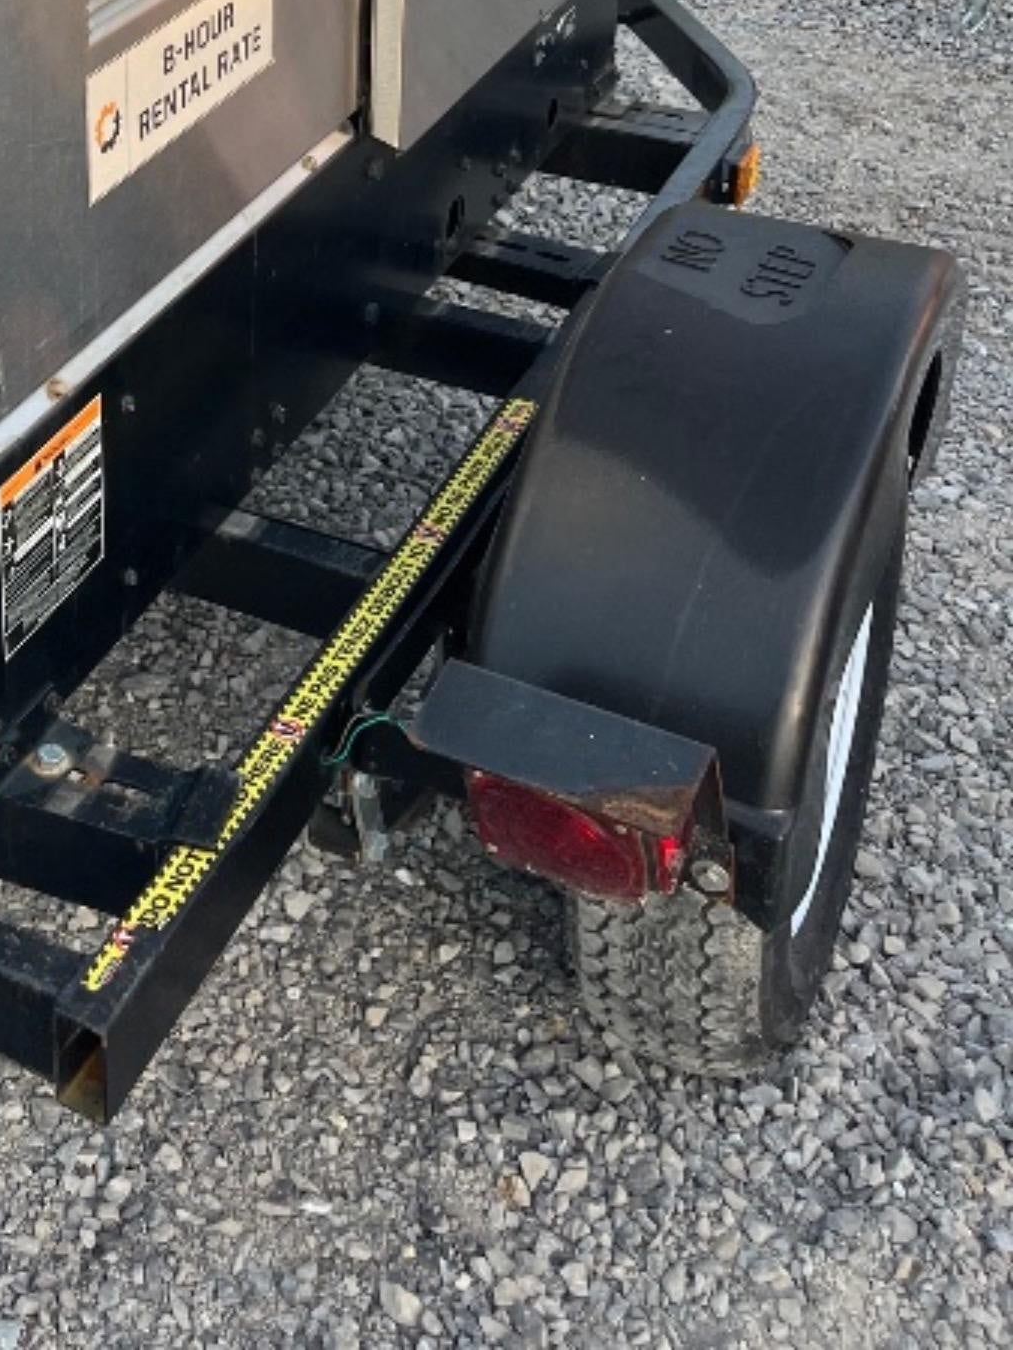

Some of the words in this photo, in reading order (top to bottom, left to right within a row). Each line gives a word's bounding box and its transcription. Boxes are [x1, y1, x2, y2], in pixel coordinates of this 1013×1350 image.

[139, 65, 212, 141] RENTAL
[217, 23, 262, 80] RATE
[660, 229, 726, 274] NO
[739, 244, 817, 307] STEP
[139, 894, 171, 930] DO
